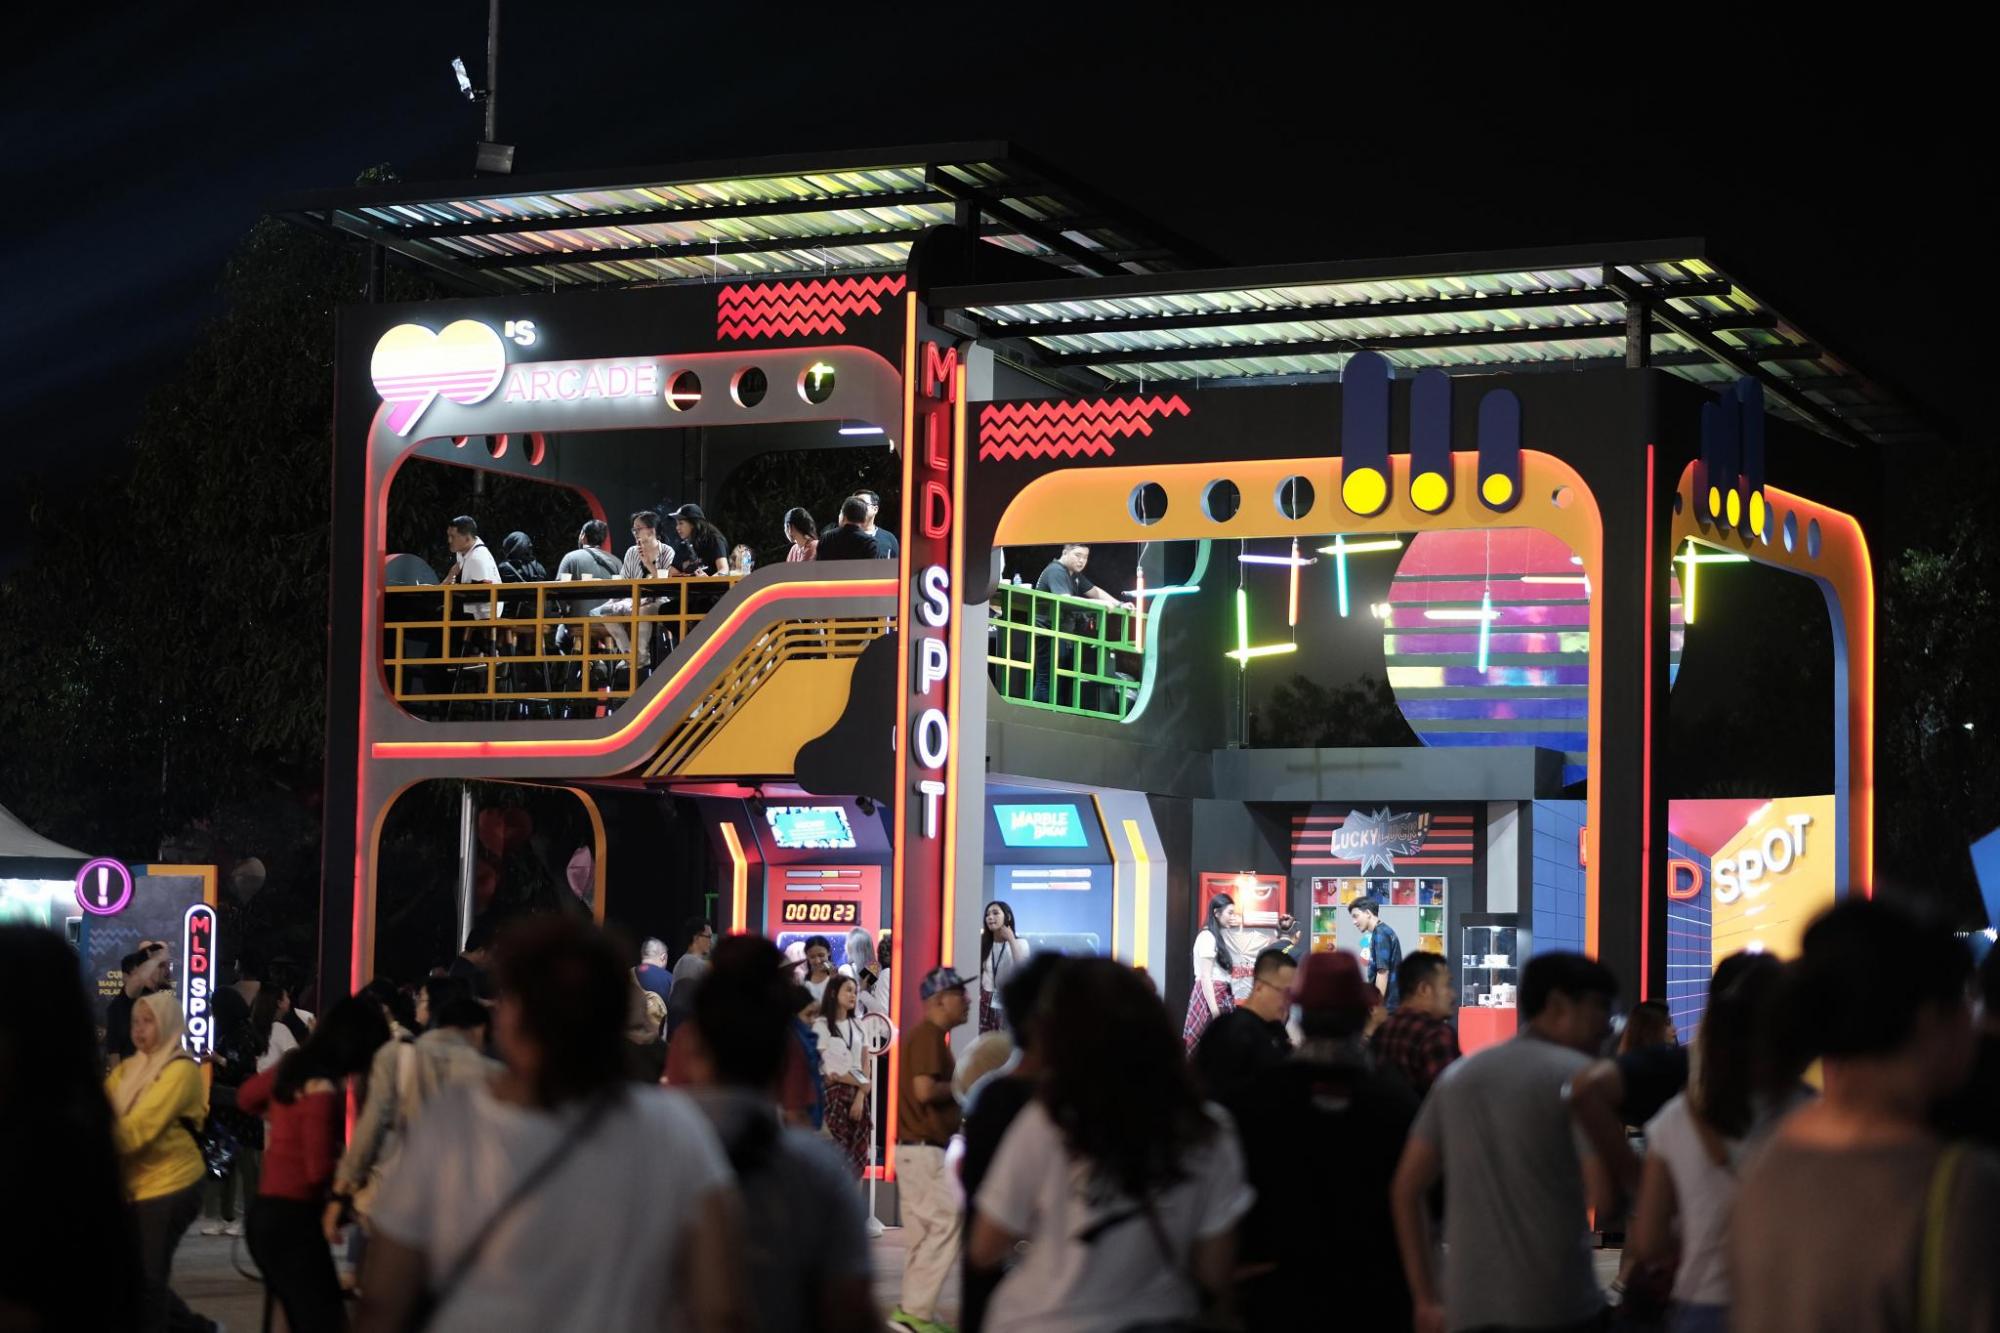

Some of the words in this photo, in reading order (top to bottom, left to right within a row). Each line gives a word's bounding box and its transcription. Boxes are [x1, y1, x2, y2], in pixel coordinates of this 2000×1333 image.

[504, 364, 658, 403] ARCADE
[921, 341, 958, 540] MLD
[916, 565, 949, 839] SPOT
[1011, 810, 1069, 831] MARBLE
[1331, 828, 1379, 851] LUCKY
[1714, 813, 1813, 904] SPOT
[785, 904, 807, 921] 00
[809, 904, 831, 921] 00
[832, 904, 855, 921] 23
[191, 915, 210, 973] MLD
[188, 977, 207, 1063] SPOT
